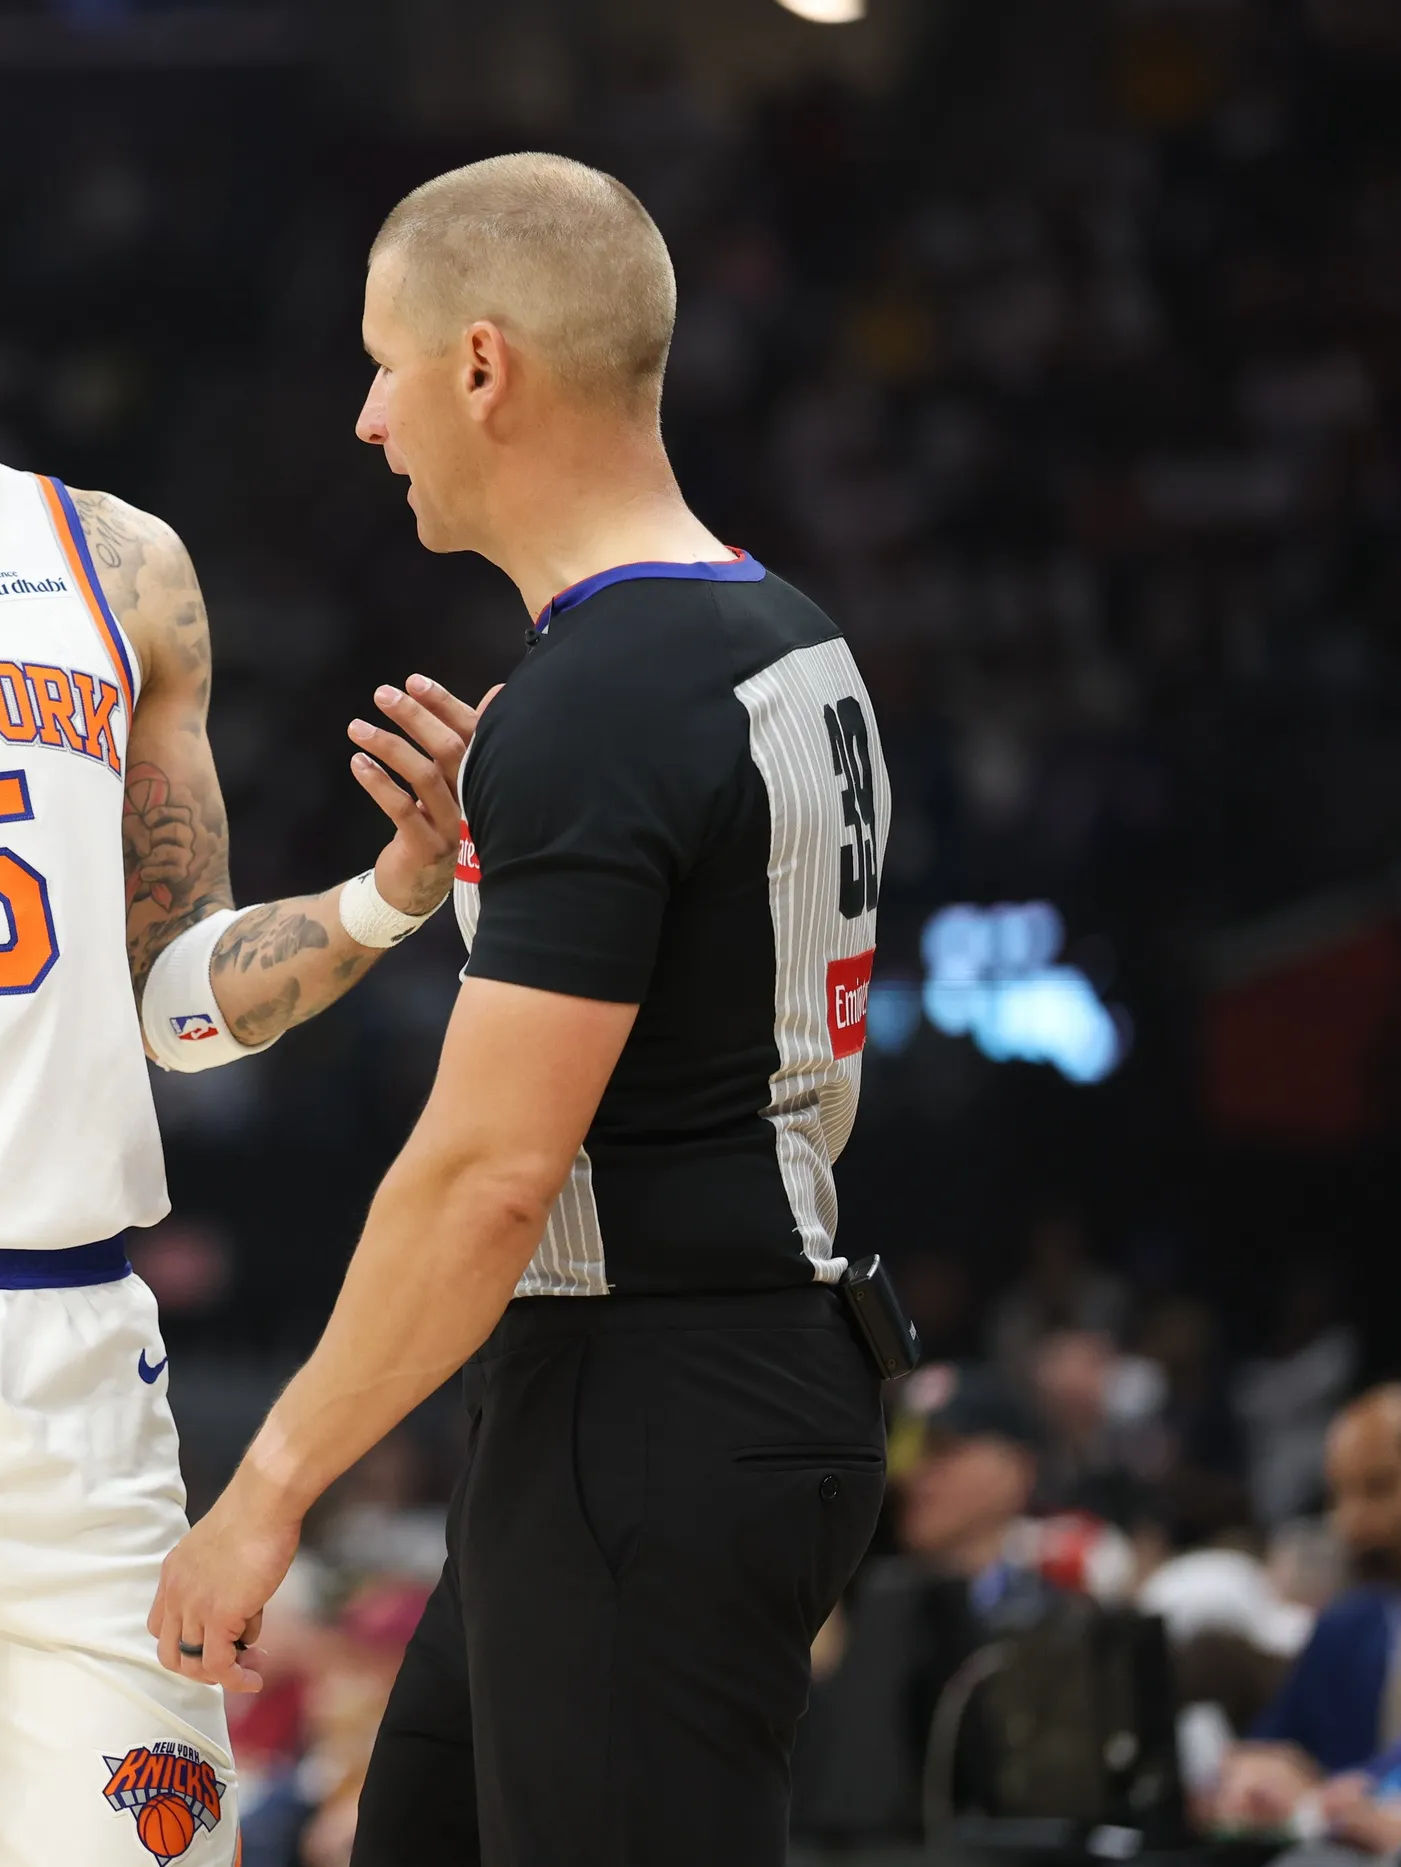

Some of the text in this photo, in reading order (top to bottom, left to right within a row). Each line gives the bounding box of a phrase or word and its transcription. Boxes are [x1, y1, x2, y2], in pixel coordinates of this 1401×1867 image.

[11, 577, 67, 593] dhabi
[823, 695, 879, 920] 39
[152, 1741, 200, 1763] NEW YORK
[103, 1746, 221, 1821] KNICKS
